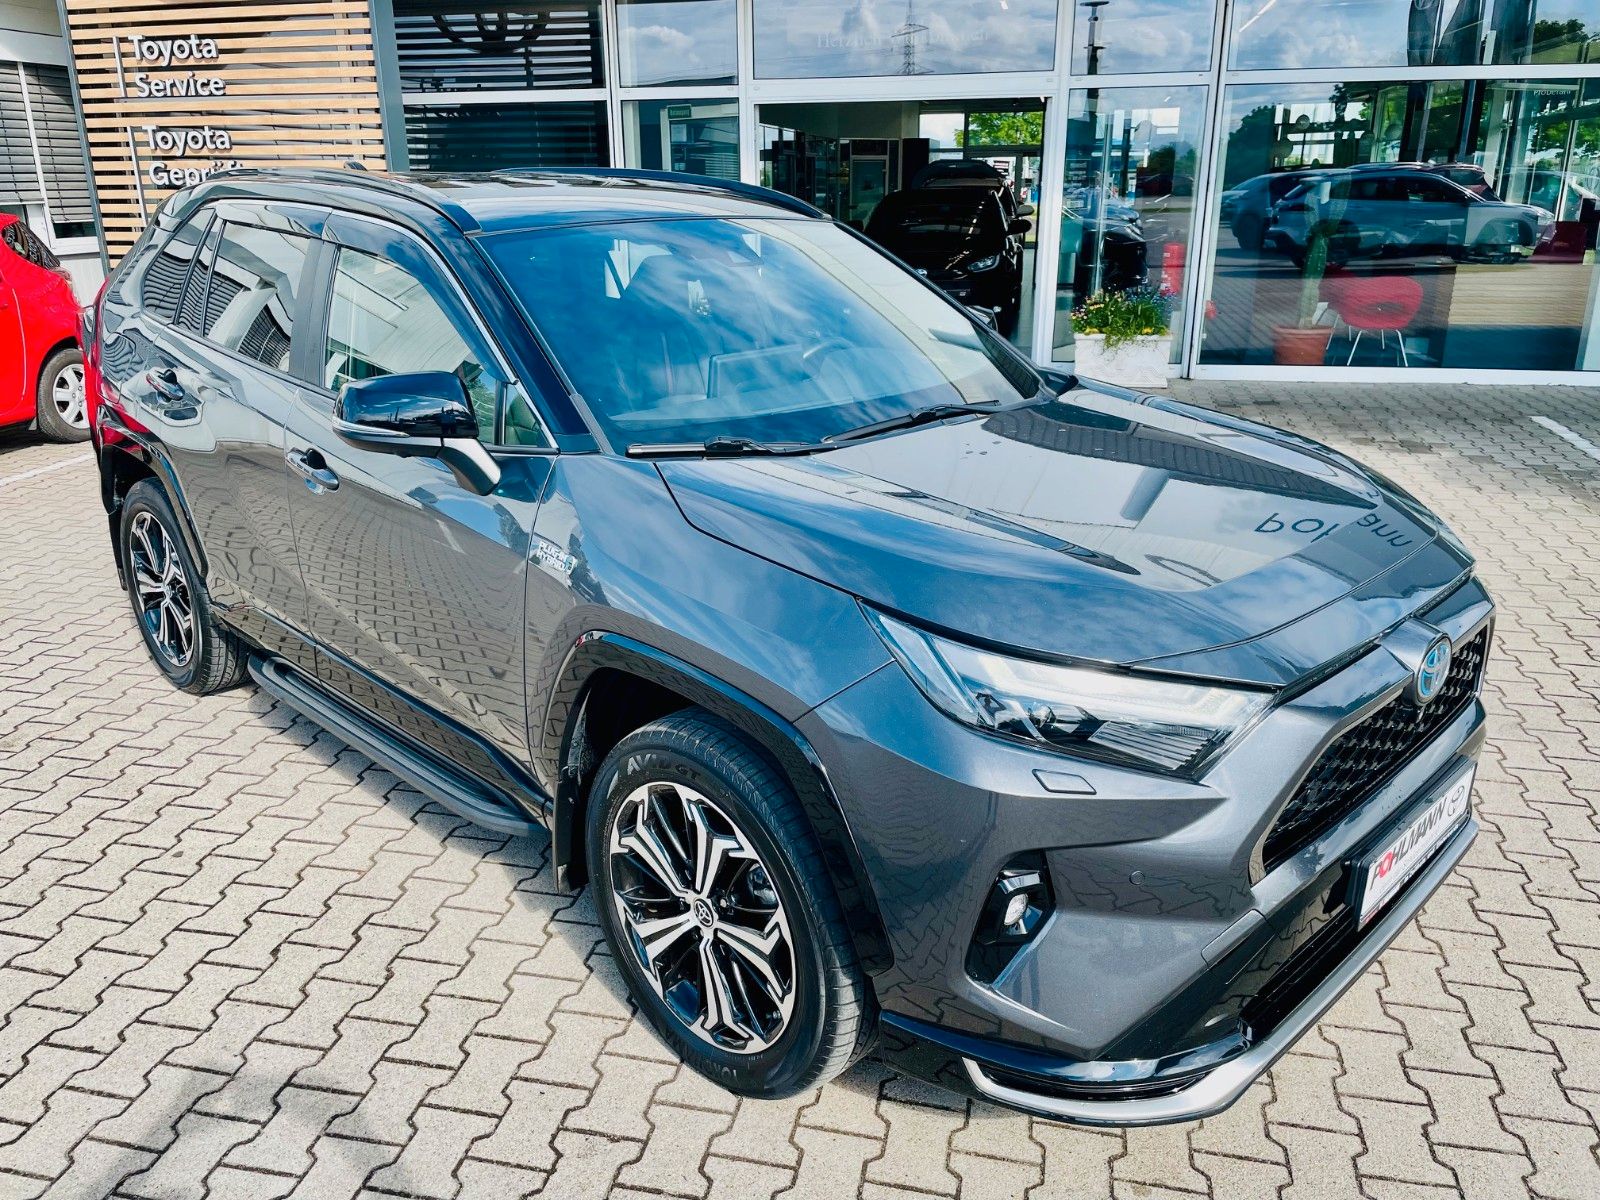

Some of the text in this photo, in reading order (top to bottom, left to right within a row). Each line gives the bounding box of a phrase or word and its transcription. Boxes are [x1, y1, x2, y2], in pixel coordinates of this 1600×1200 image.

[128, 33, 218, 67] Toyota
[135, 71, 225, 98] Service
[142, 125, 231, 156] Toyota
[1370, 796, 1447, 890] POHLMANN
